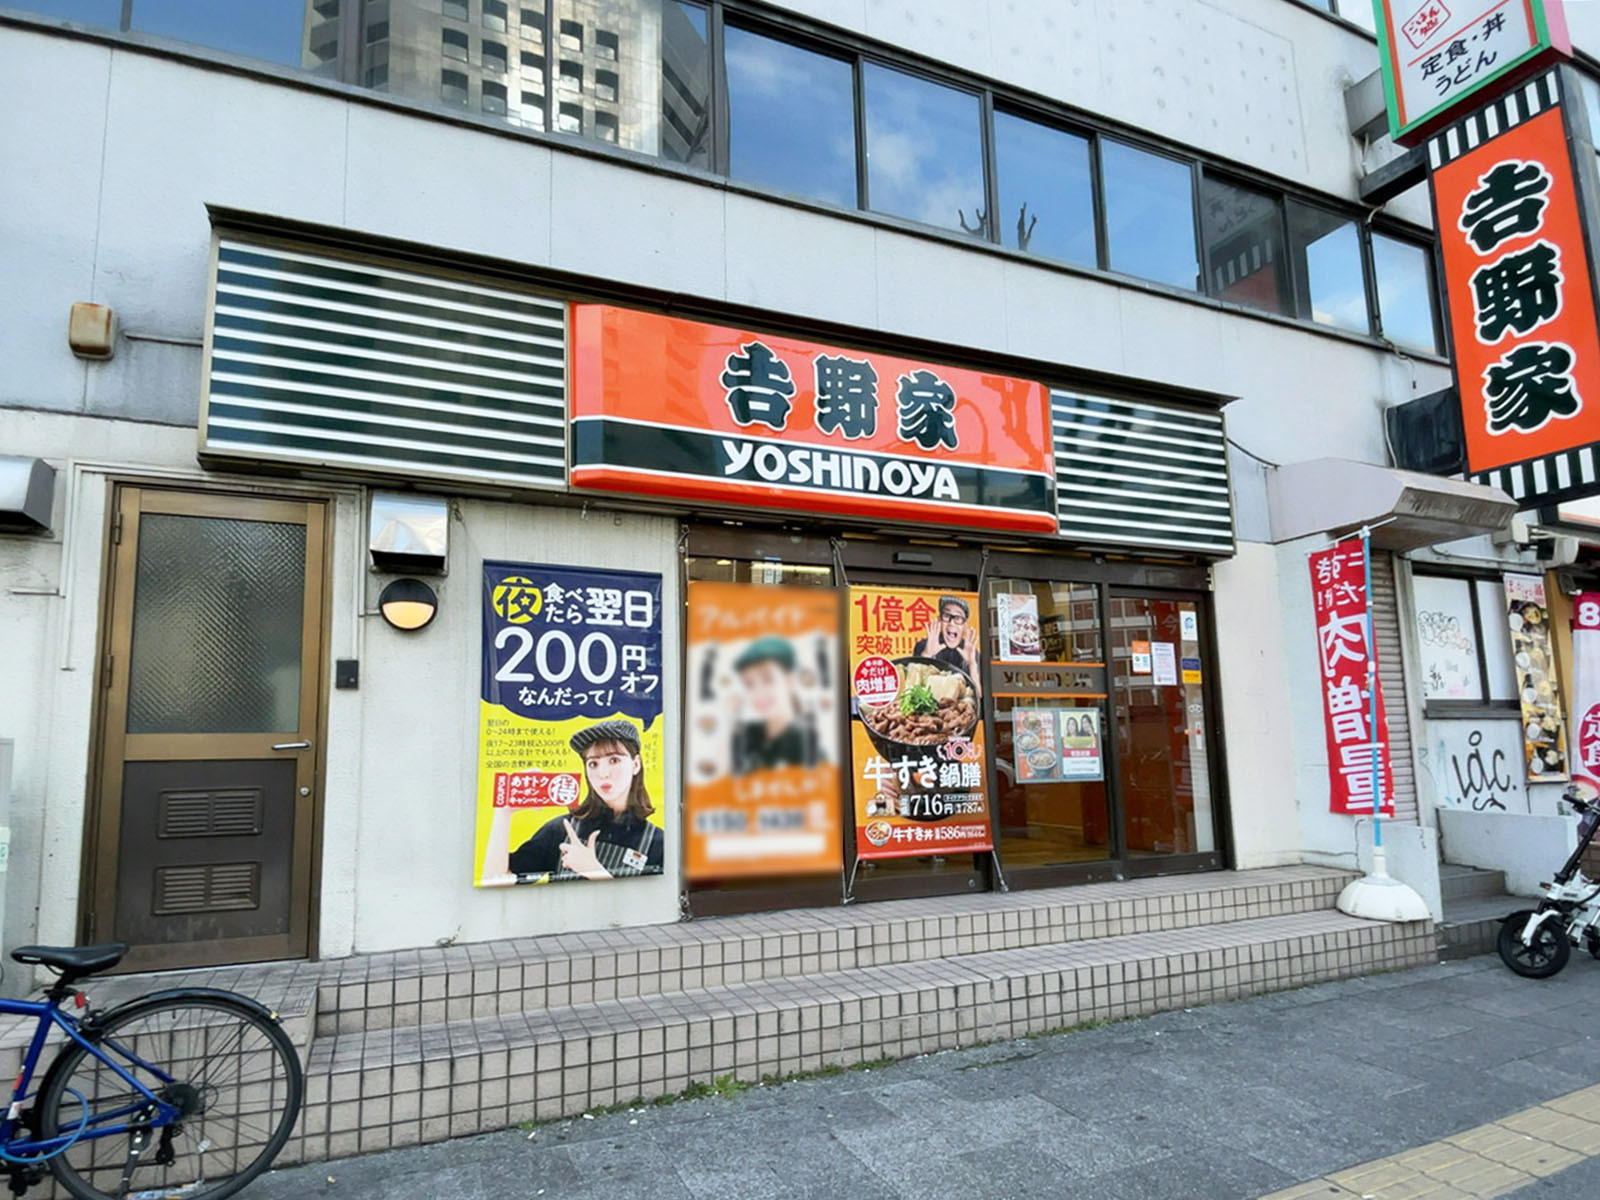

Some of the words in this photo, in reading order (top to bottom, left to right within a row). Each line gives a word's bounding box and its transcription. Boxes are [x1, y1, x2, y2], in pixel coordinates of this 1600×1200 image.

[1421, 13, 1506, 80] 定食・丼
[1435, 51, 1497, 95] うどん
[1458, 159, 1582, 436] 吉野家
[720, 341, 960, 451] 吉野家
[722, 440, 960, 500] YOSHINOYA
[518, 686, 614, 706] なんだって!
